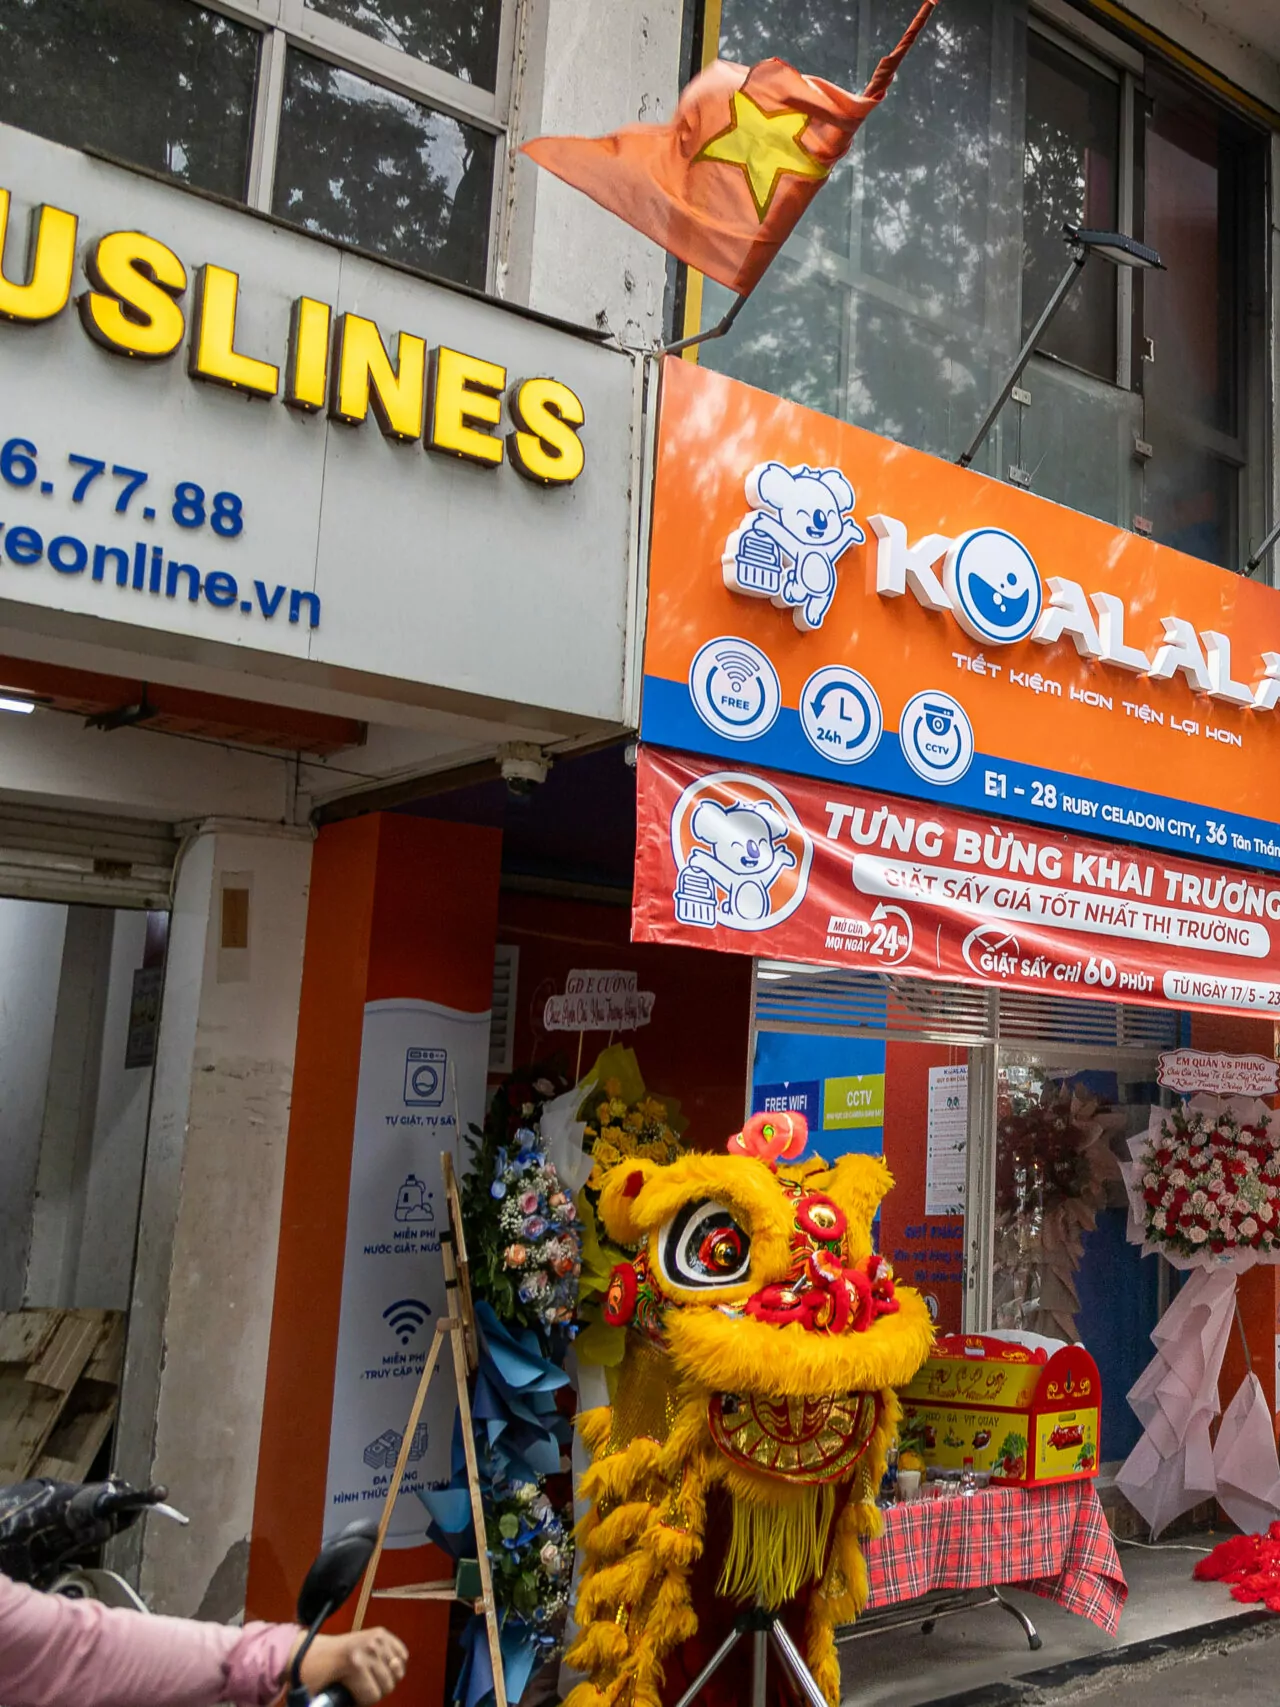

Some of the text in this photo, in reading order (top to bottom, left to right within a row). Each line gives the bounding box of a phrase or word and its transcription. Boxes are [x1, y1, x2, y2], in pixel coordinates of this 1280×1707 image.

[0, 522, 321, 629] eonline.vn
[721, 695, 750, 711] FREE
[1069, 686, 1113, 711] HƠN
[1122, 701, 1164, 725] TIỆN
[1170, 715, 1200, 737] LỢI
[1205, 727, 1242, 747] HƠN
[816, 727, 842, 745] 24h
[925, 742, 950, 756] CCTV
[984, 769, 1007, 799] E1
[1030, 780, 1057, 809] 28
[1062, 795, 1099, 818] RUBY
[1101, 804, 1165, 833] CELADON
[1167, 818, 1200, 844] CITY,
[1205, 820, 1228, 846] 36
[1230, 832, 1252, 852] Tân
[953, 825, 1063, 881] BỪNG
[1072, 851, 1154, 898] KHAI
[883, 867, 1250, 947] GIẶT SẤY GIÁ TỐT NHẤT THỊ TRƯỜNG
[825, 935, 844, 951] MỌI
[845, 937, 870, 953] NGÀY
[869, 922, 899, 957] 24
[980, 951, 1017, 980] GIẶT
[1021, 955, 1052, 980] SẤY
[1083, 956, 1117, 987] 60
[1119, 970, 1154, 992] PHÚT
[1173, 976, 1191, 996] TỪ
[1192, 979, 1227, 1000] NGÀY
[1230, 985, 1257, 1006] 17/5
[1176, 1057, 1189, 1065] EM
[1221, 1061, 1232, 1069] VS
[764, 1094, 807, 1112] FREE WIFI
[847, 1090, 872, 1107] CCTV
[385, 1115, 399, 1127] TỰ
[426, 1115, 438, 1127] TỰ
[393, 1227, 436, 1239] MIỄN PHÍ
[363, 1241, 392, 1255] NƯỚC
[382, 1351, 426, 1365] MIỄN PHÍ
[365, 1365, 413, 1381] TRUY CẬP
[373, 1474, 387, 1486] ĐA
[333, 1489, 358, 1504] HÌNH
